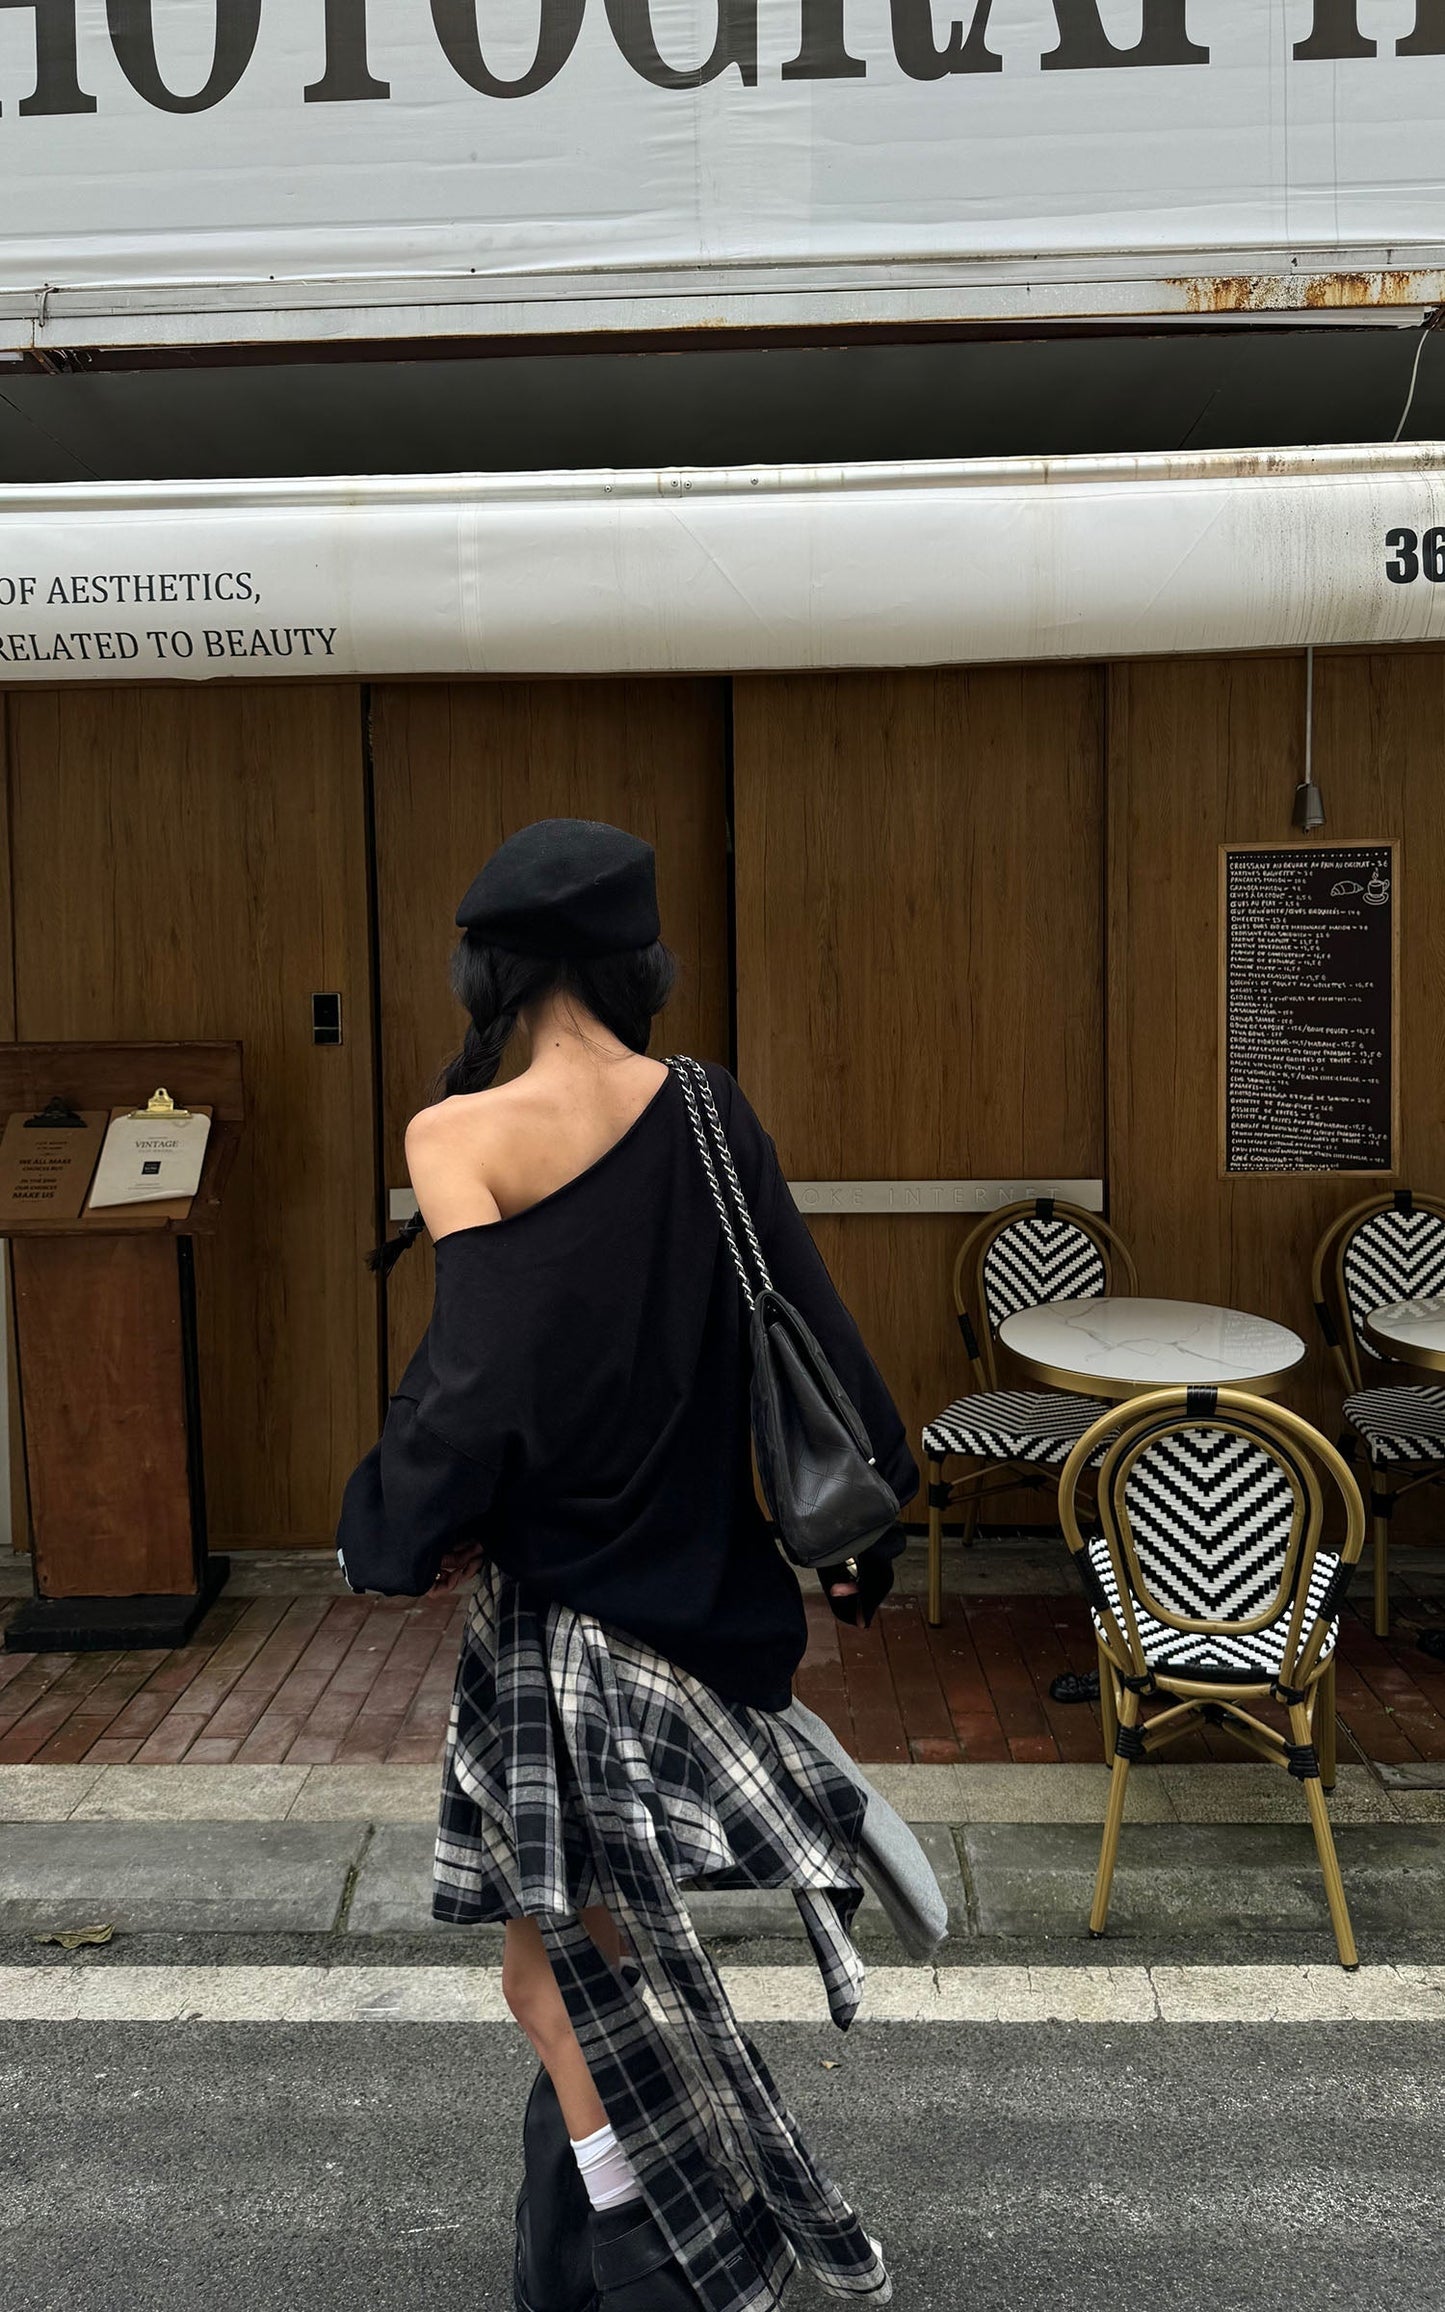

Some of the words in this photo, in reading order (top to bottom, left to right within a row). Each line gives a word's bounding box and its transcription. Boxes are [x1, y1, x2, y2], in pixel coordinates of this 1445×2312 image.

[1385, 526, 1445, 584] 36
[0, 577, 36, 605] OF
[46, 572, 261, 604] AESTHETICS,
[147, 630, 194, 658] TO
[203, 627, 337, 658] BEAUTY
